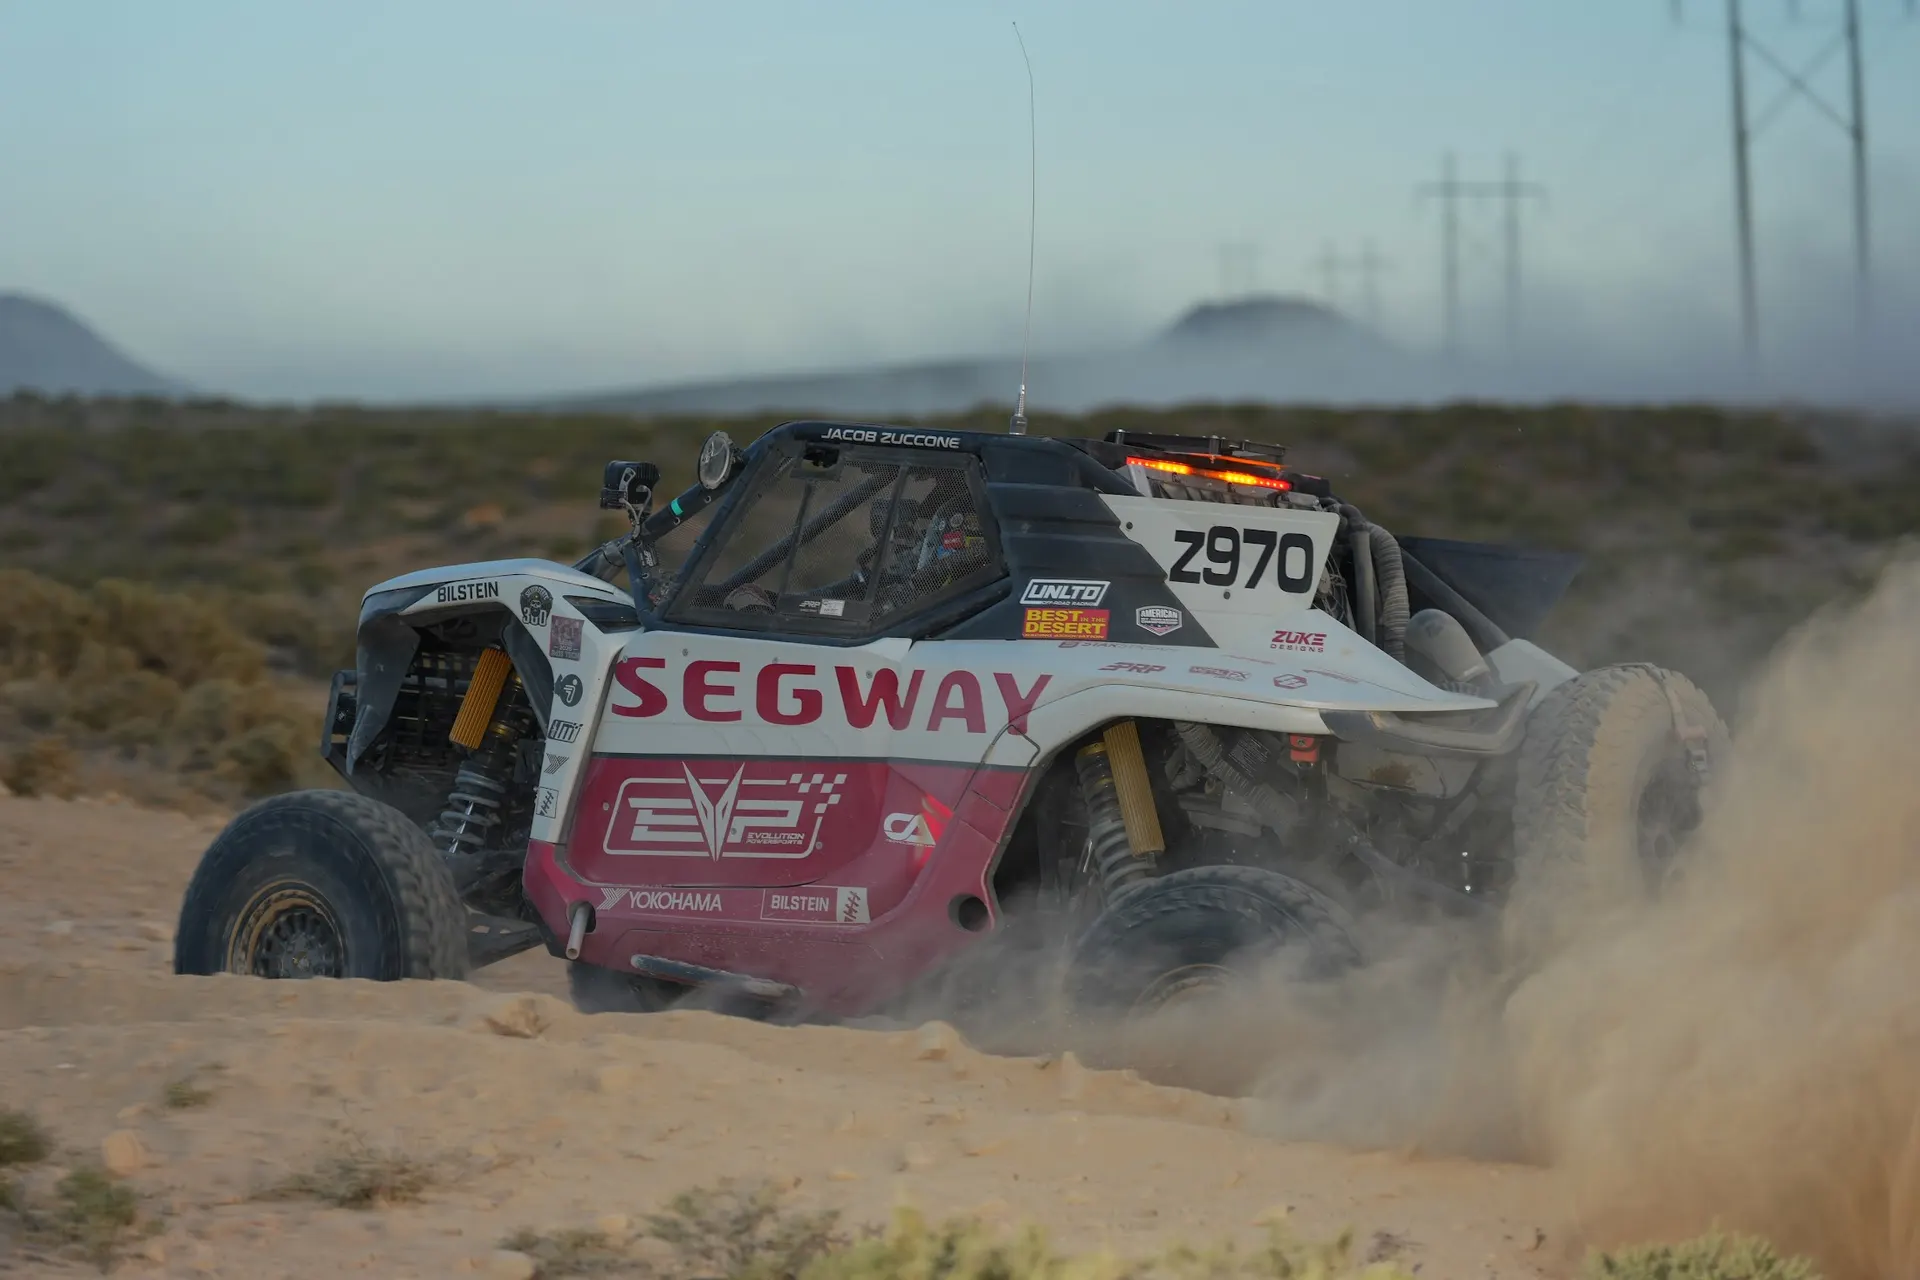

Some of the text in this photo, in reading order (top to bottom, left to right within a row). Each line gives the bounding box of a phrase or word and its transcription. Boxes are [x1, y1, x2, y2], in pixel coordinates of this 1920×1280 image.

[821, 428, 960, 449] JACOB ZUCCONE
[1169, 525, 1314, 594] Z970
[438, 581, 499, 603] BILSTEIN
[1027, 584, 1102, 600] UNLTD
[1026, 608, 1084, 621] BEST
[1140, 608, 1178, 619] AMERICAN
[1024, 621, 1106, 634] DESERT
[1271, 630, 1327, 646] ZUKE
[1270, 643, 1324, 653] DESIGNS
[611, 656, 1053, 735] SEGWAY
[747, 832, 805, 840] EVOLUTION
[629, 891, 722, 912] YOKOHAMA
[771, 895, 830, 912] BILSTEIN
